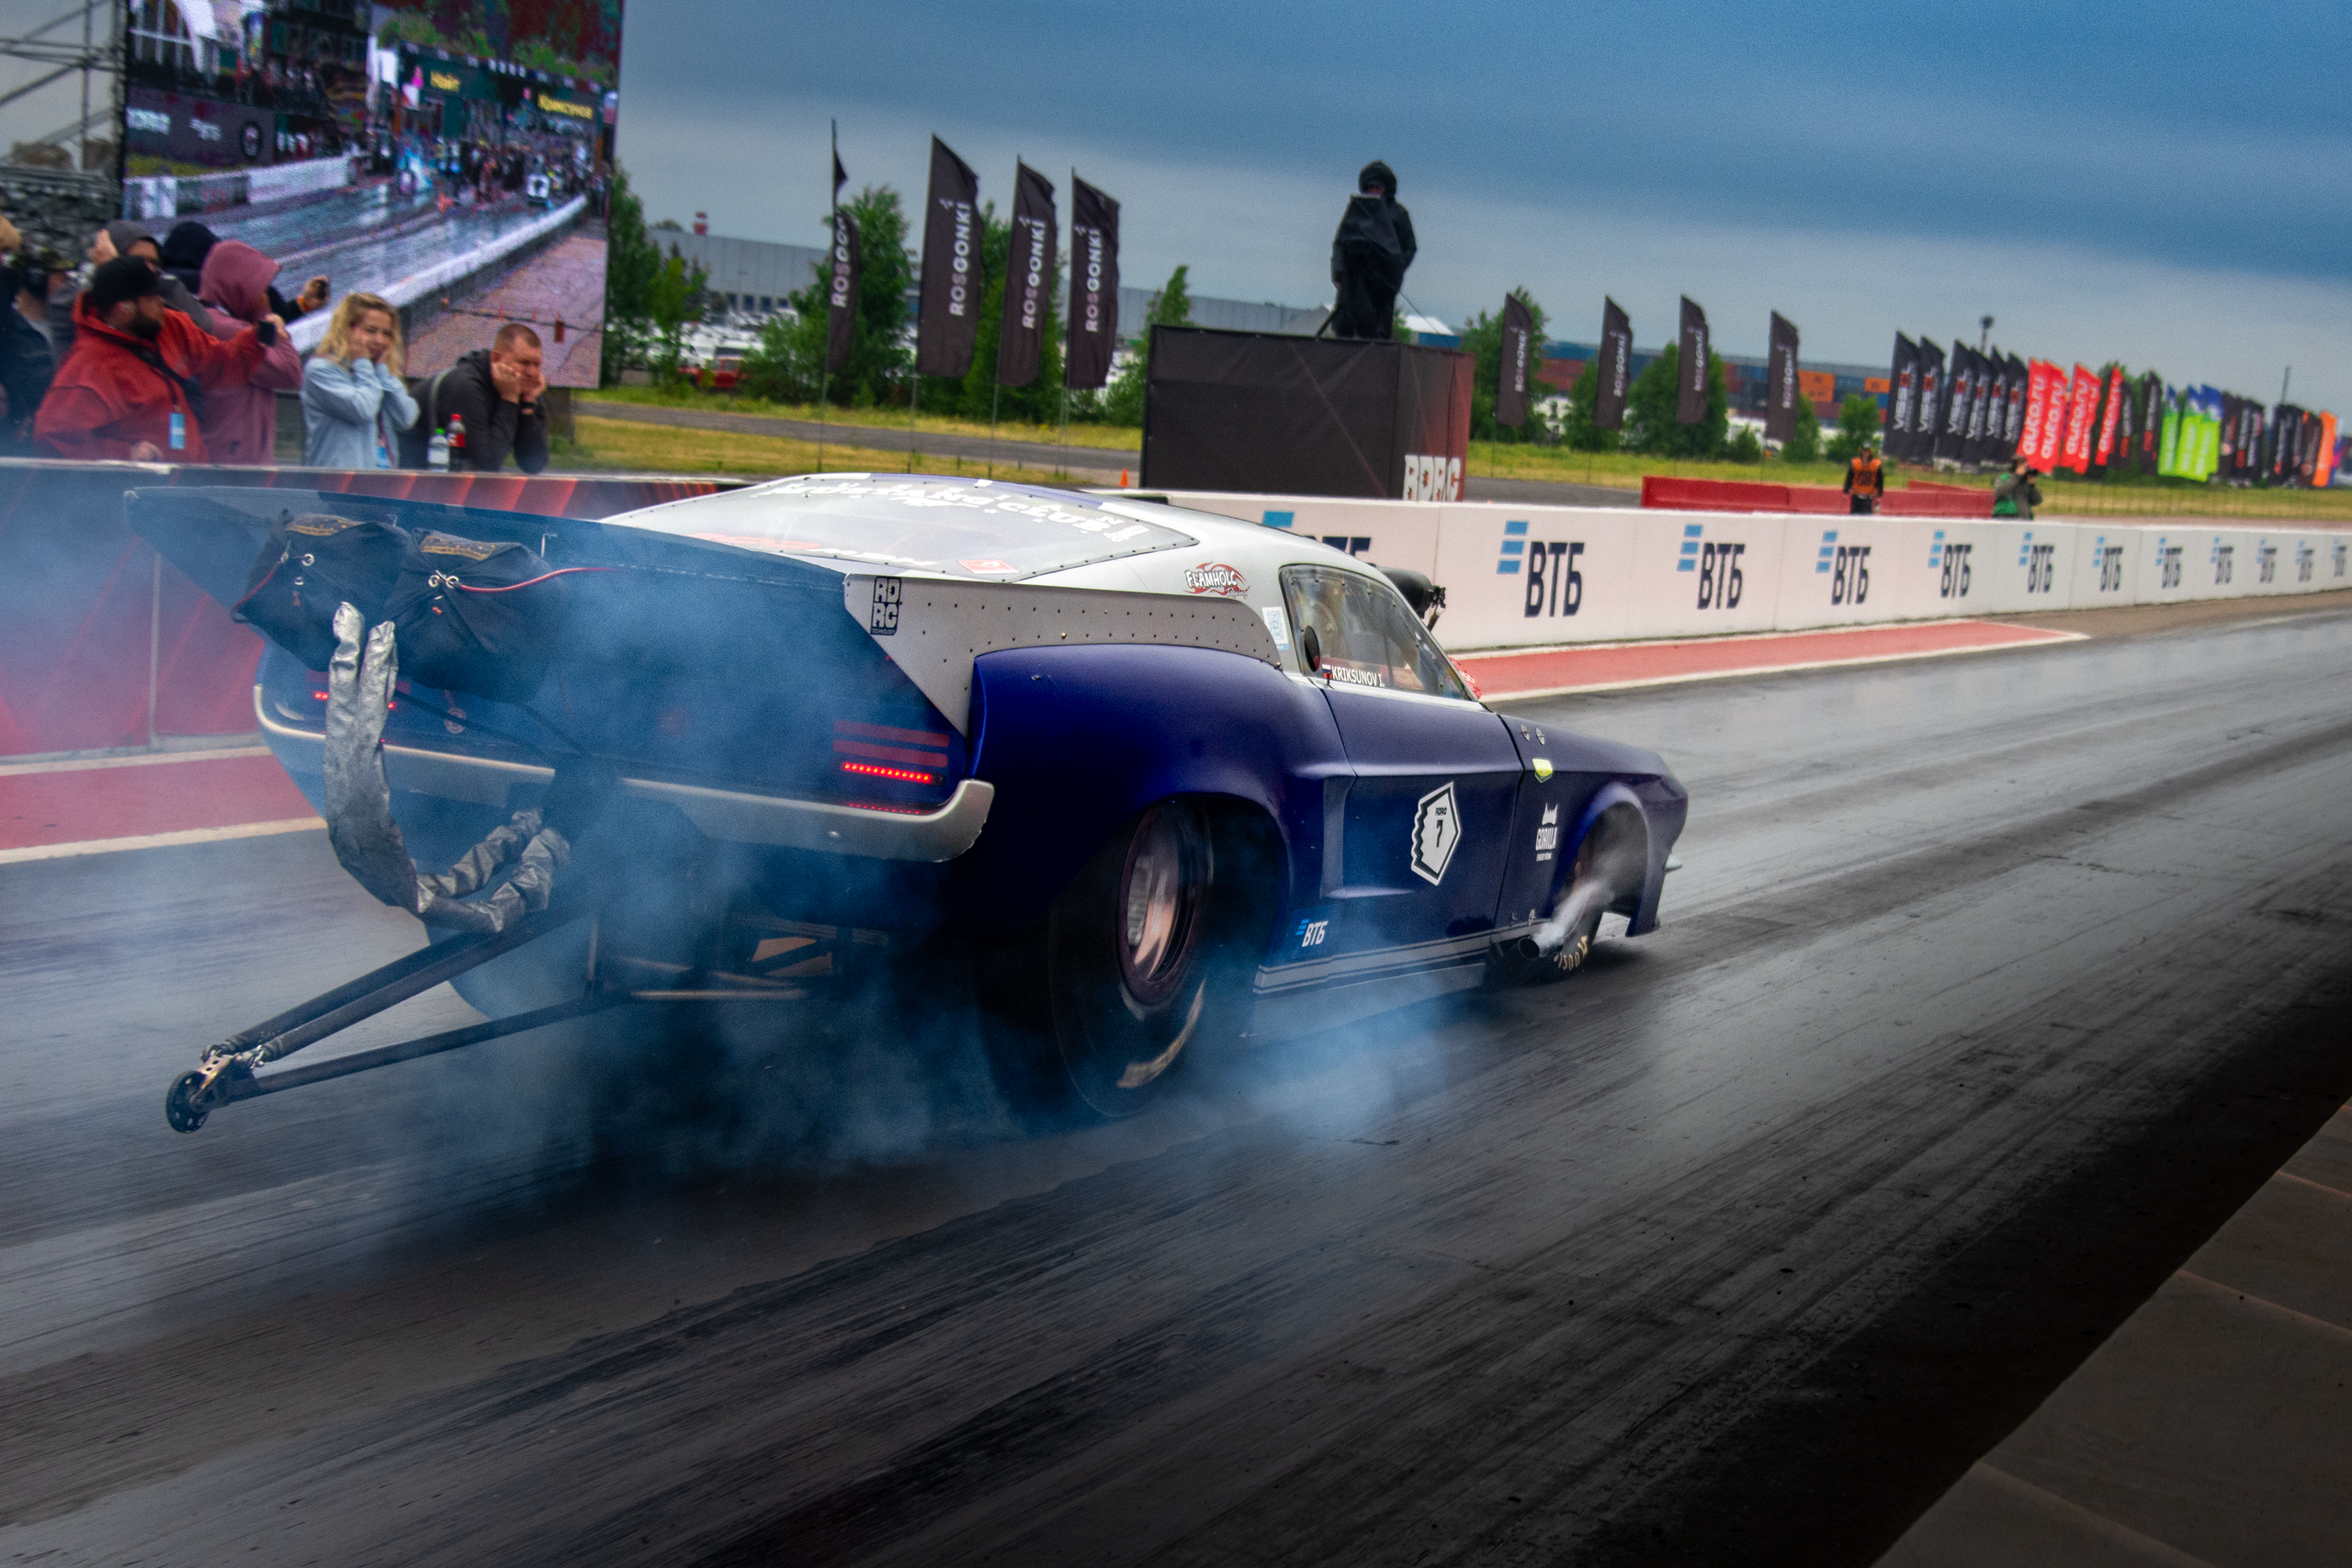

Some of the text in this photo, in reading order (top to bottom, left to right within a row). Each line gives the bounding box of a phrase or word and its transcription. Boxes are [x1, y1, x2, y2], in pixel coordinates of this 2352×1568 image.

[948, 202, 971, 317] ROSGONKI
[1022, 219, 1046, 329] ROSGONKI
[1085, 227, 1102, 333] ROSGONKI
[2022, 376, 2047, 456] auto.ru
[2041, 381, 2064, 459] auto.ru
[2065, 379, 2089, 455] auto.ru
[753, 486, 1112, 532] MUSTANG CLUB
[1184, 570, 1238, 589] FLAMHOLC
[1524, 541, 1586, 617] ВТБ
[1697, 543, 1746, 610] ВТБ
[1831, 546, 1871, 606] ВТБ
[1940, 544, 1973, 599] ВТБ
[2028, 544, 2055, 593] ВТБ
[1331, 668, 1385, 688] KRIKSUNOV I.
[1436, 819, 1443, 848] 7
[1535, 826, 1558, 852] GORILLA
[1301, 920, 1329, 947] ВТБ
